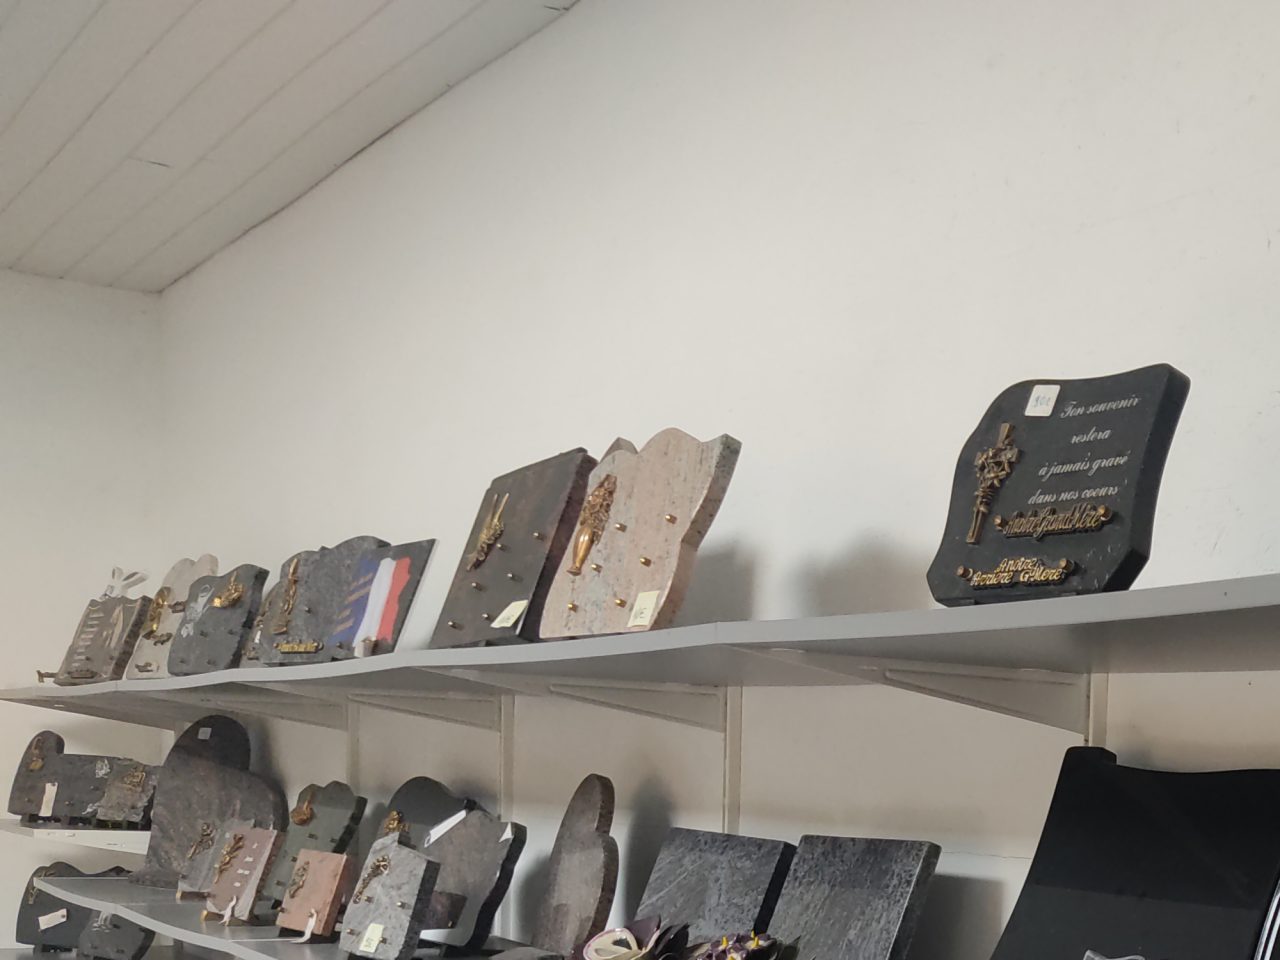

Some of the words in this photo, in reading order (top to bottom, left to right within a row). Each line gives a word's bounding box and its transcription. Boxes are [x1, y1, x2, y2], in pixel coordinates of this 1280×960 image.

[1060, 401, 1084, 418] Ton
[1086, 394, 1140, 414] souvenir
[1071, 426, 1112, 444] restera
[1041, 457, 1091, 482] jamais
[1028, 488, 1056, 505] dans
[1058, 489, 1079, 502] nos
[1081, 485, 1119, 499] coeurs
